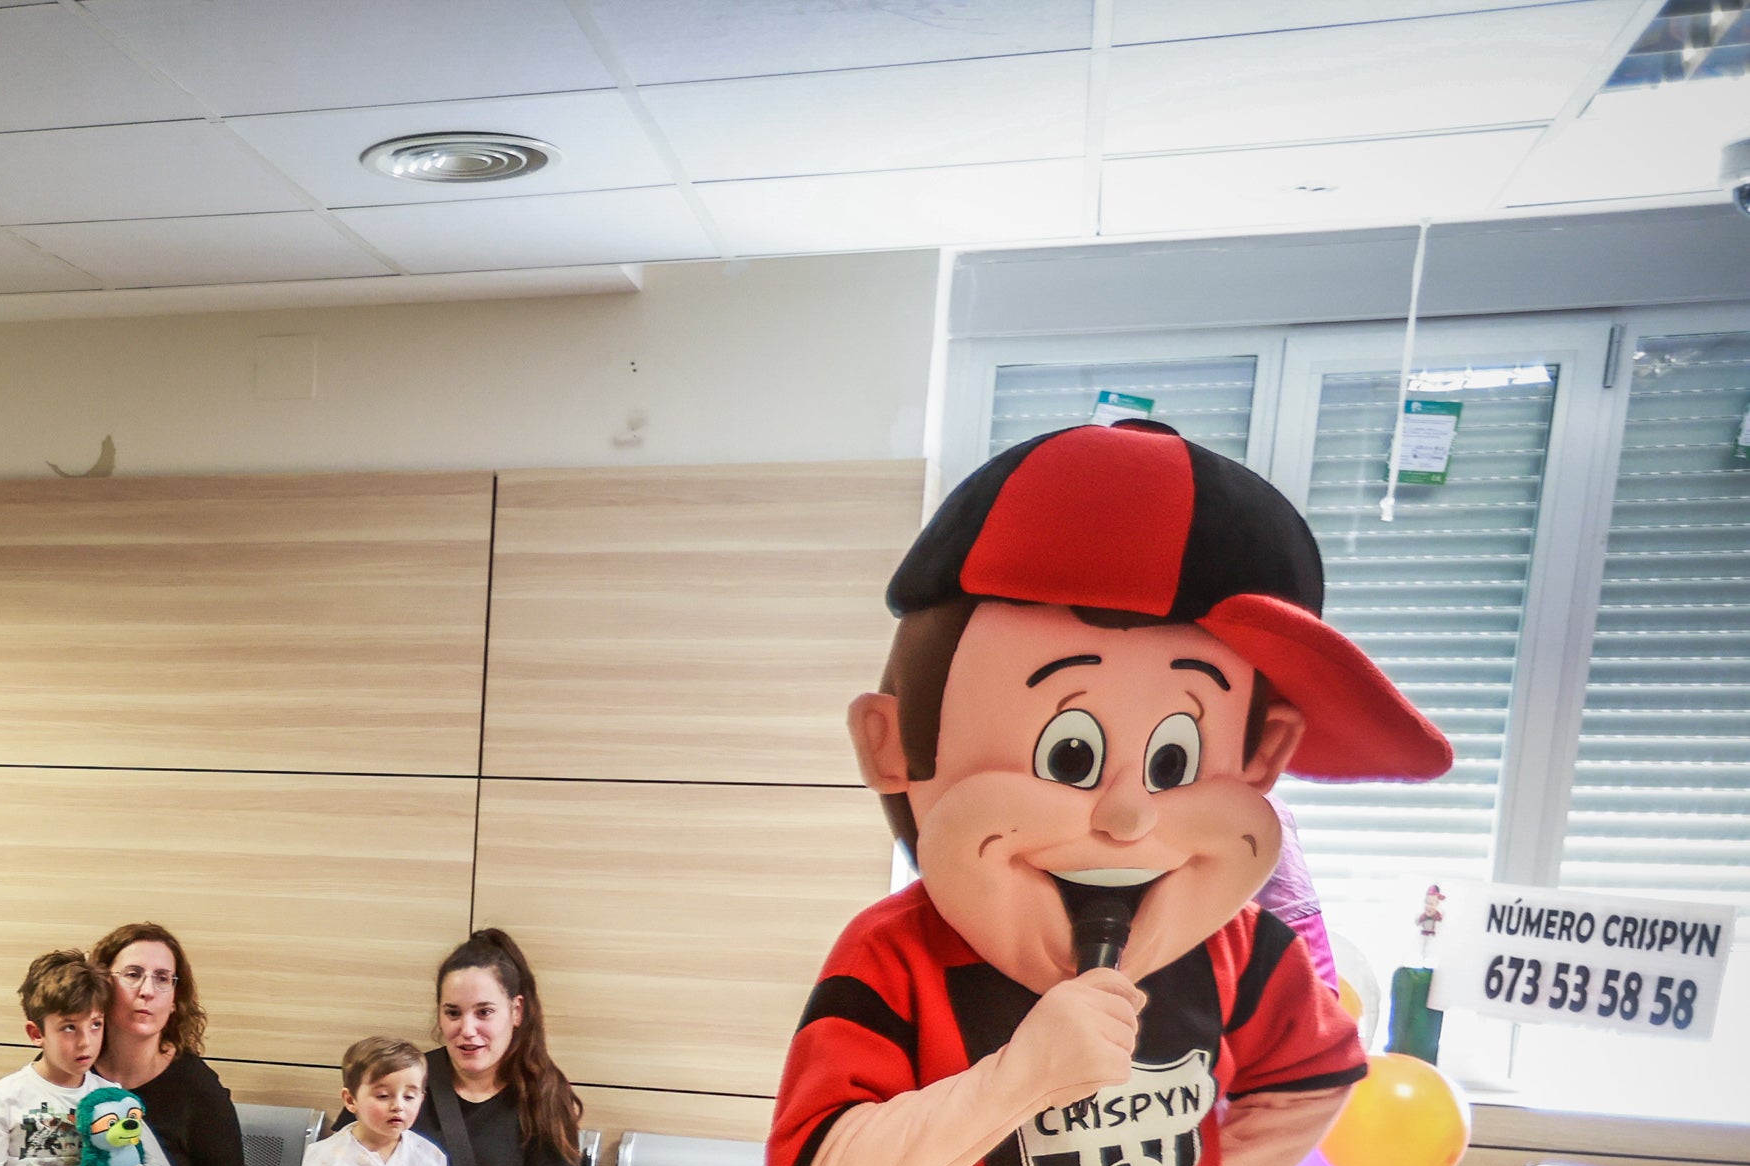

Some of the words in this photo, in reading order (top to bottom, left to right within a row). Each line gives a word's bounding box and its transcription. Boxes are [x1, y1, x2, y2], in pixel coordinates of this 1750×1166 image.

[1486, 898, 1595, 944] NÚMERO
[1602, 914, 1722, 958] CRISPYN
[1484, 955, 1542, 1005] 673
[1548, 961, 1591, 1013] 53
[1597, 968, 1643, 1021] 58
[1649, 975, 1698, 1030] 58
[1034, 1084, 1200, 1136] CRISPYN
